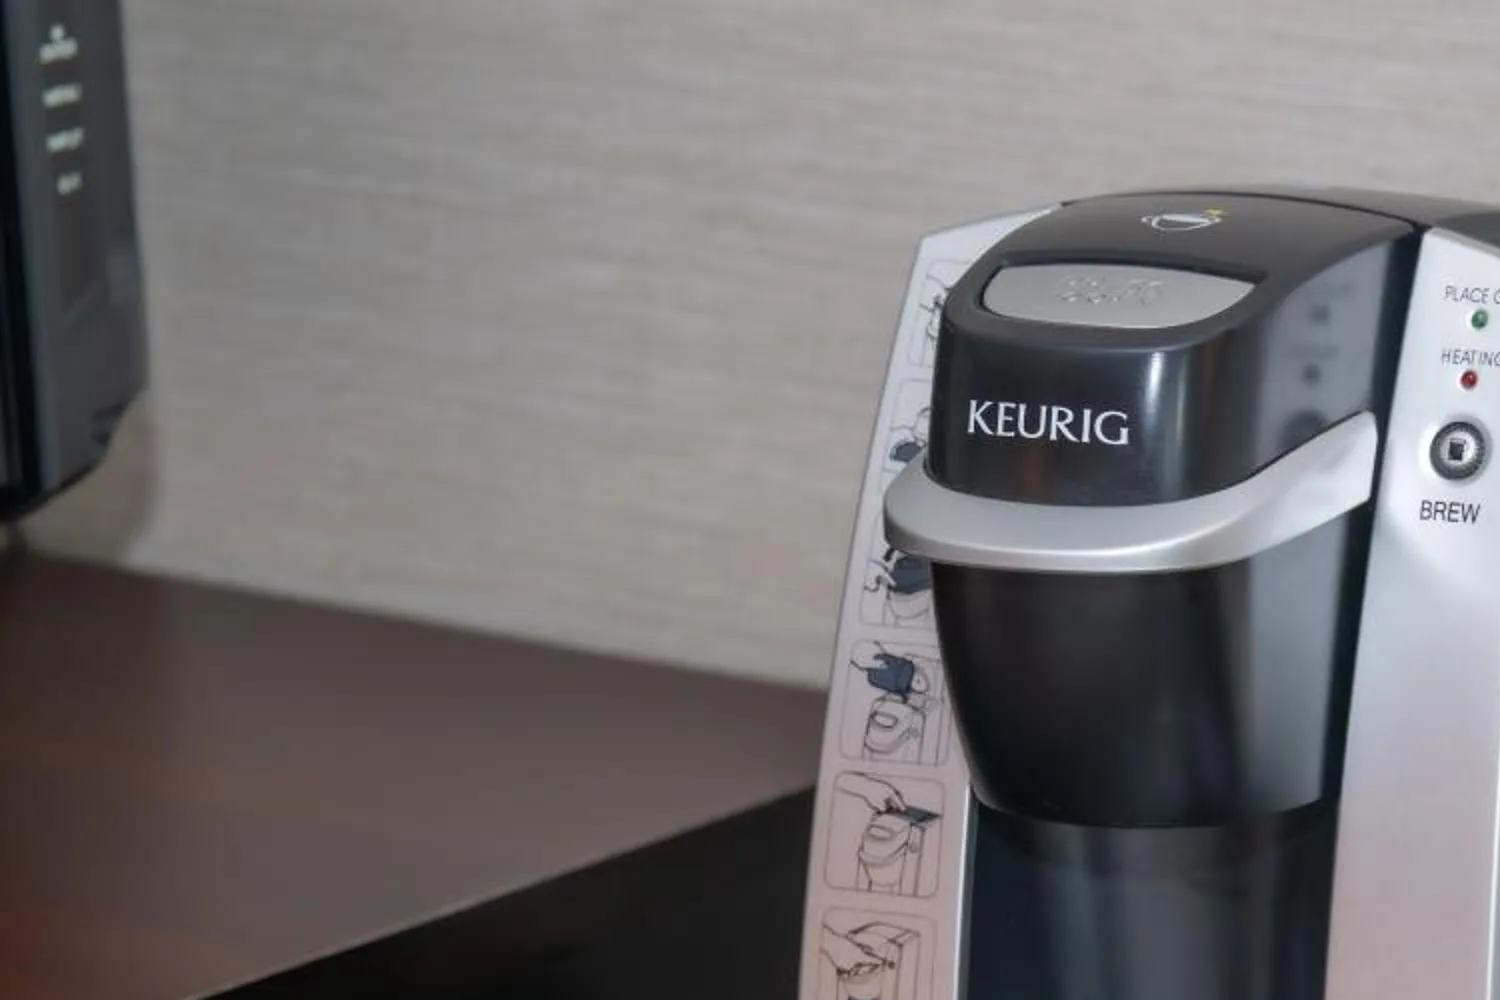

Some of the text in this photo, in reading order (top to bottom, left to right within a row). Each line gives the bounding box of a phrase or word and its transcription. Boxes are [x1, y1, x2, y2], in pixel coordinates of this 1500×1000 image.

[1444, 285, 1490, 304] PLACE
[967, 399, 1129, 445] KEURIG
[1419, 499, 1481, 524] BREW
